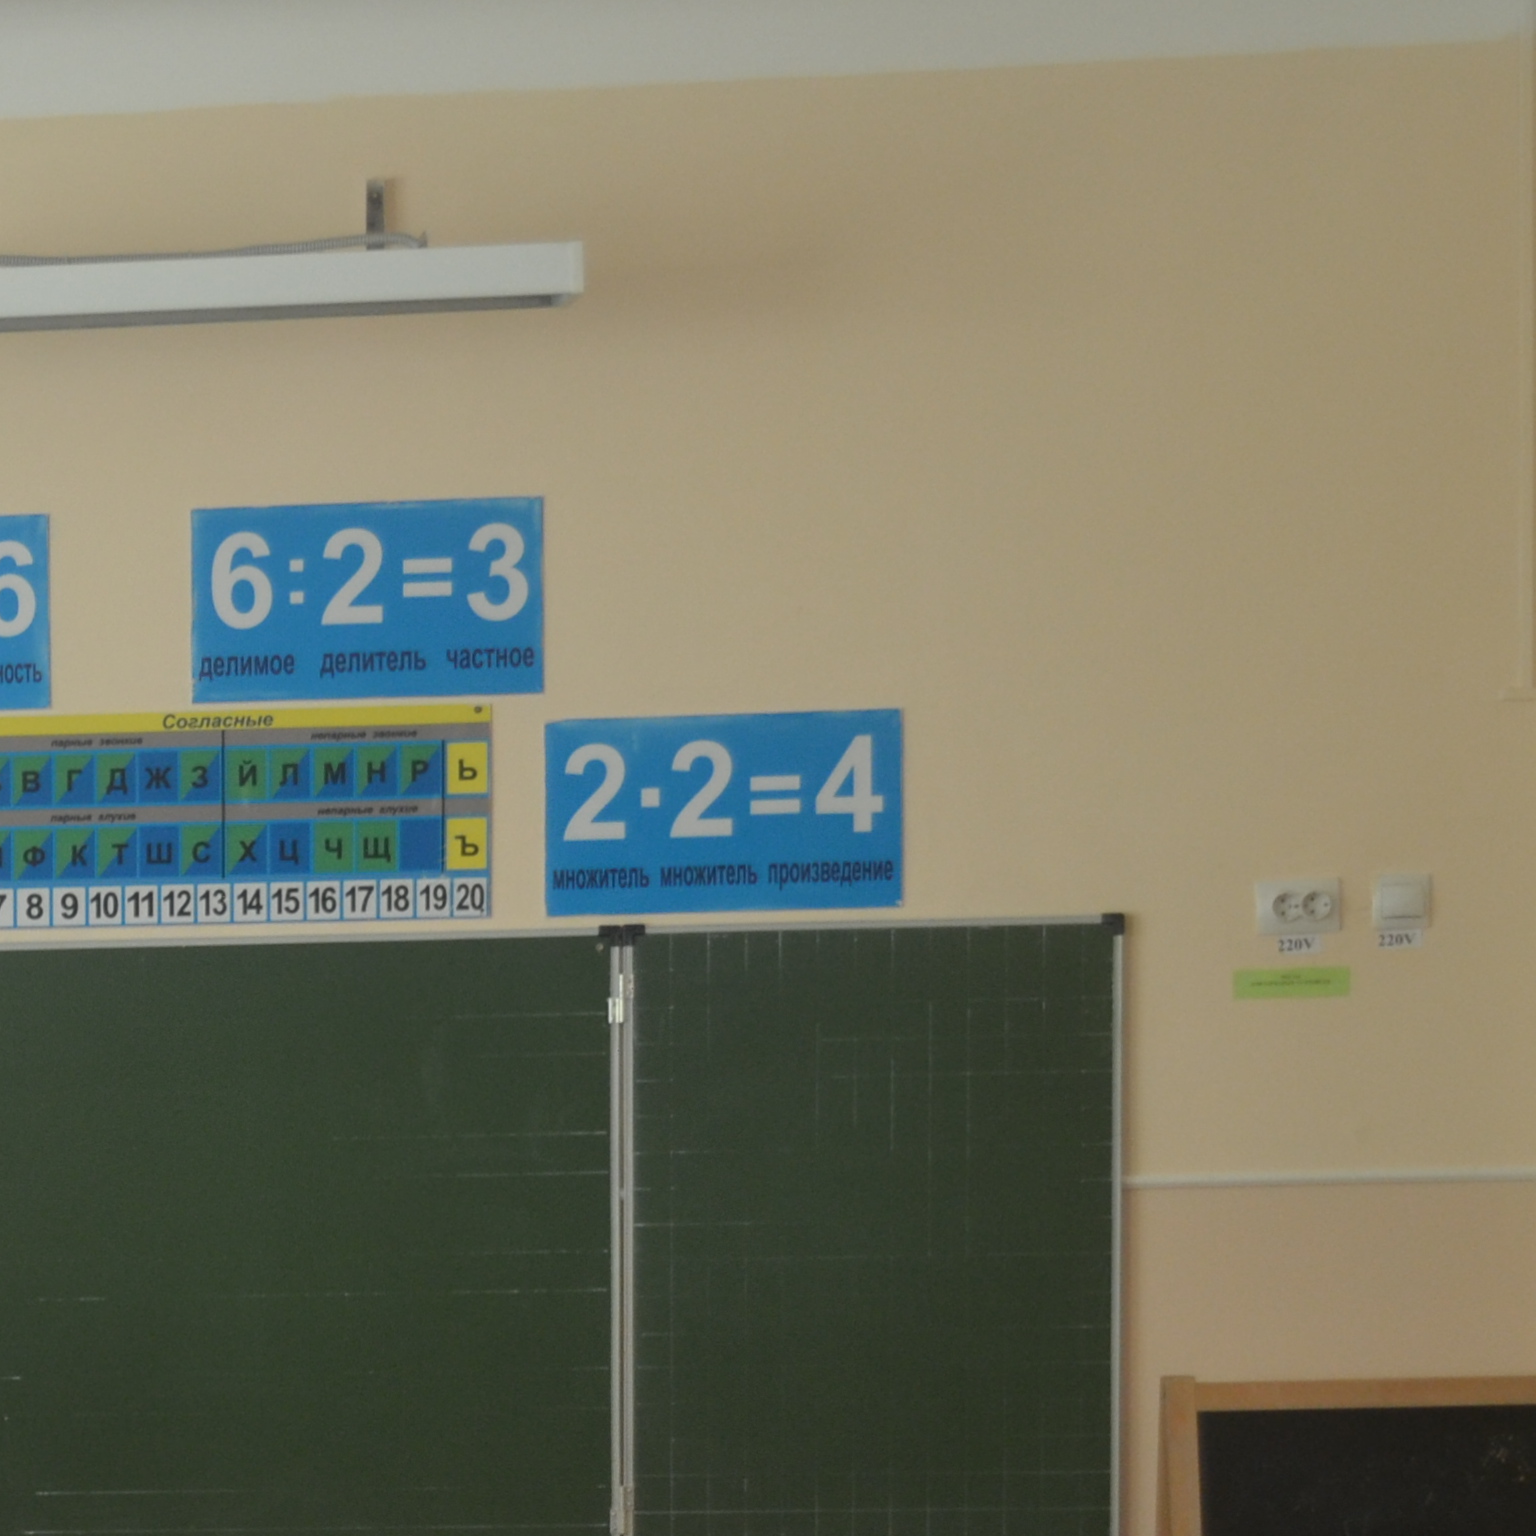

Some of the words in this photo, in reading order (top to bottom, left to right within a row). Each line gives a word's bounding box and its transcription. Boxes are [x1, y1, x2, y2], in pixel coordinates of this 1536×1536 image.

[199, 653, 294, 681] делимое
[320, 650, 426, 678] делитель
[446, 647, 534, 670] частное
[162, 713, 273, 729] Согласные
[50, 739, 92, 749] парные
[311, 731, 367, 742] непарные
[22, 770, 41, 793] В
[67, 769, 83, 792] Г
[106, 768, 128, 795] Д
[145, 767, 172, 789] Ж
[192, 766, 208, 788] З
[239, 760, 257, 787] Й
[279, 763, 299, 786] Л
[324, 762, 346, 785] М
[367, 761, 386, 784] Н
[411, 760, 429, 783] Р
[458, 759, 477, 781] Ь
[50, 813, 92, 824] парные
[317, 806, 373, 817] непарные
[23, 845, 45, 867] Ф
[71, 845, 87, 866] К
[112, 843, 129, 865] Т
[146, 843, 172, 864] Ш
[192, 842, 210, 863] С
[238, 840, 257, 862] Х
[279, 840, 299, 864] Ц
[325, 838, 342, 859] Ч
[363, 838, 391, 862] Щ
[455, 835, 479, 857] Ъ
[553, 868, 650, 890] множитель
[660, 864, 757, 887] множитель
[768, 860, 894, 890] произведение
[26, 893, 43, 920] 8
[60, 893, 78, 919] 9
[90, 892, 119, 918] 10
[127, 891, 154, 918] 11
[163, 890, 191, 917] 12
[199, 889, 227, 916] 13
[236, 889, 263, 915] 14
[271, 888, 300, 914] 15
[309, 887, 336, 913] 16
[345, 886, 374, 912] 17
[381, 885, 409, 911] 18
[419, 884, 447, 910] 19
[457, 883, 485, 910] 20
[1278, 938, 1315, 953] 220V
[1378, 933, 1416, 948] 220V
